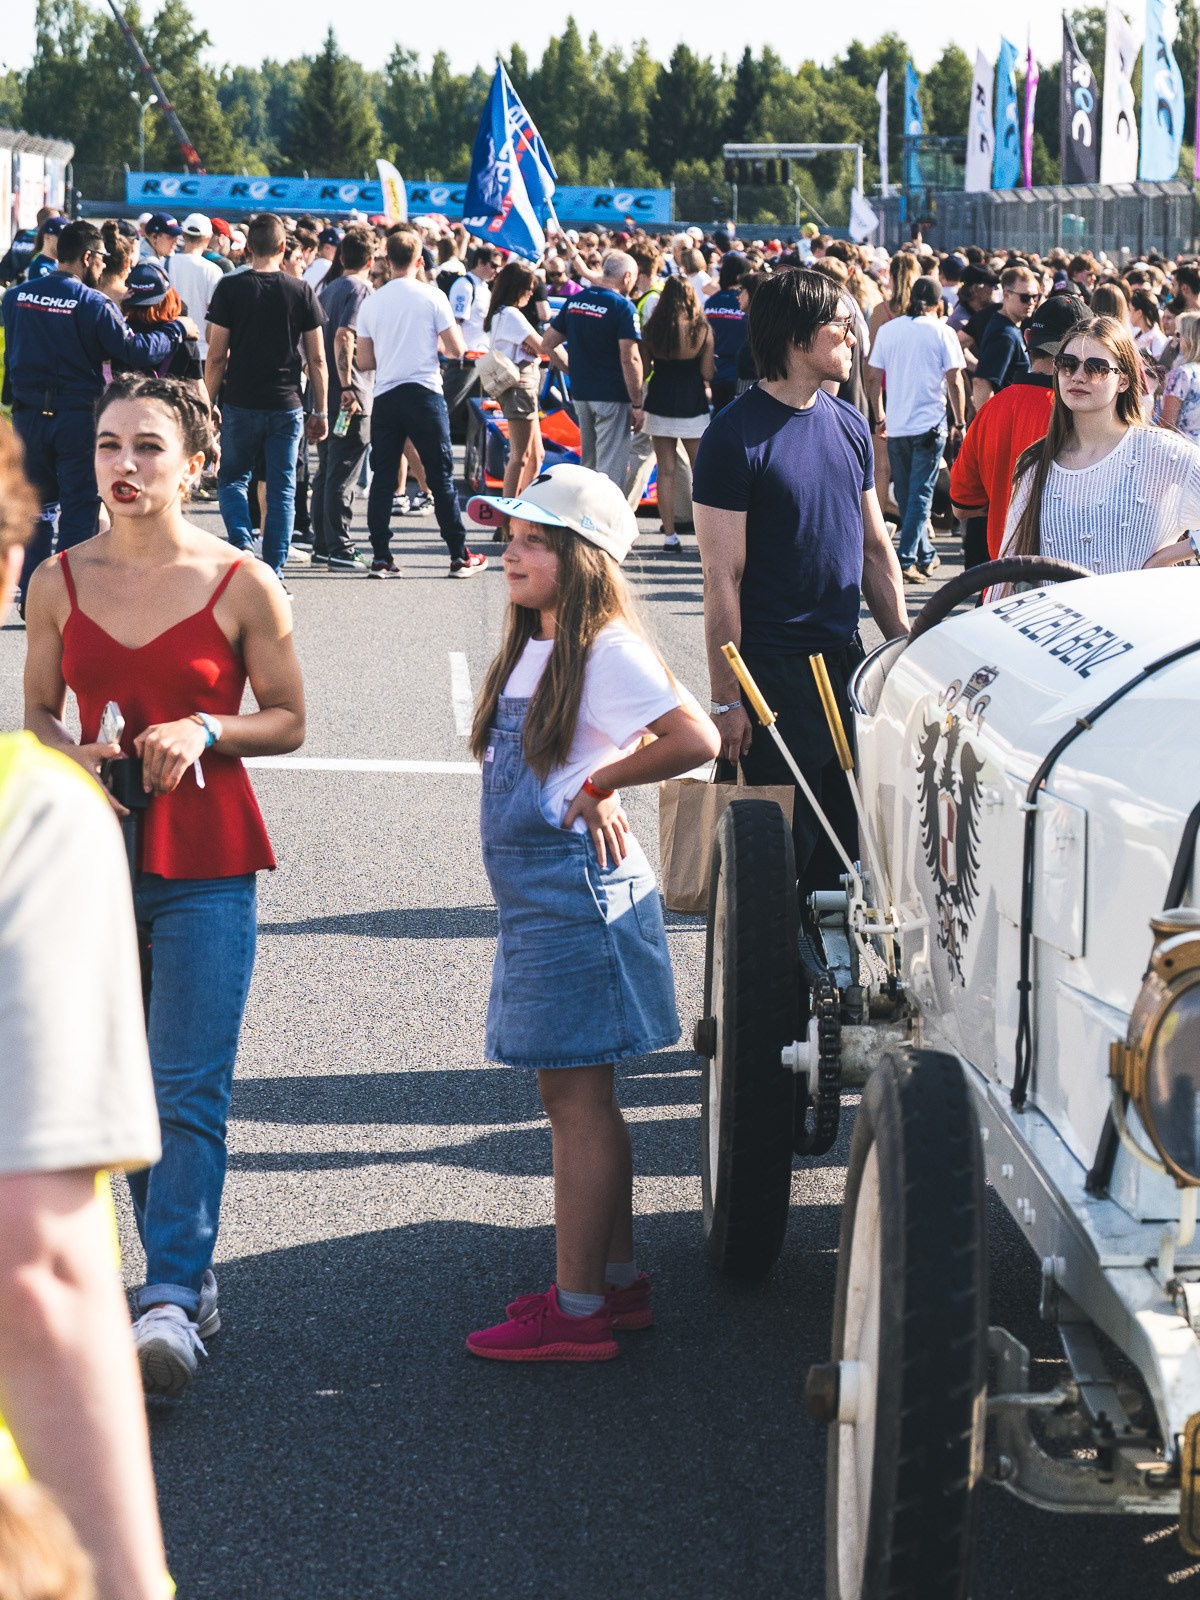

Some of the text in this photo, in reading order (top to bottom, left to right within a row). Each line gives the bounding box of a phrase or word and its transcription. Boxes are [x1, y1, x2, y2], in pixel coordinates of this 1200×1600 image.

[17, 292, 78, 309] BALCHUG
[992, 592, 1134, 679] BLITZEN BENZ
